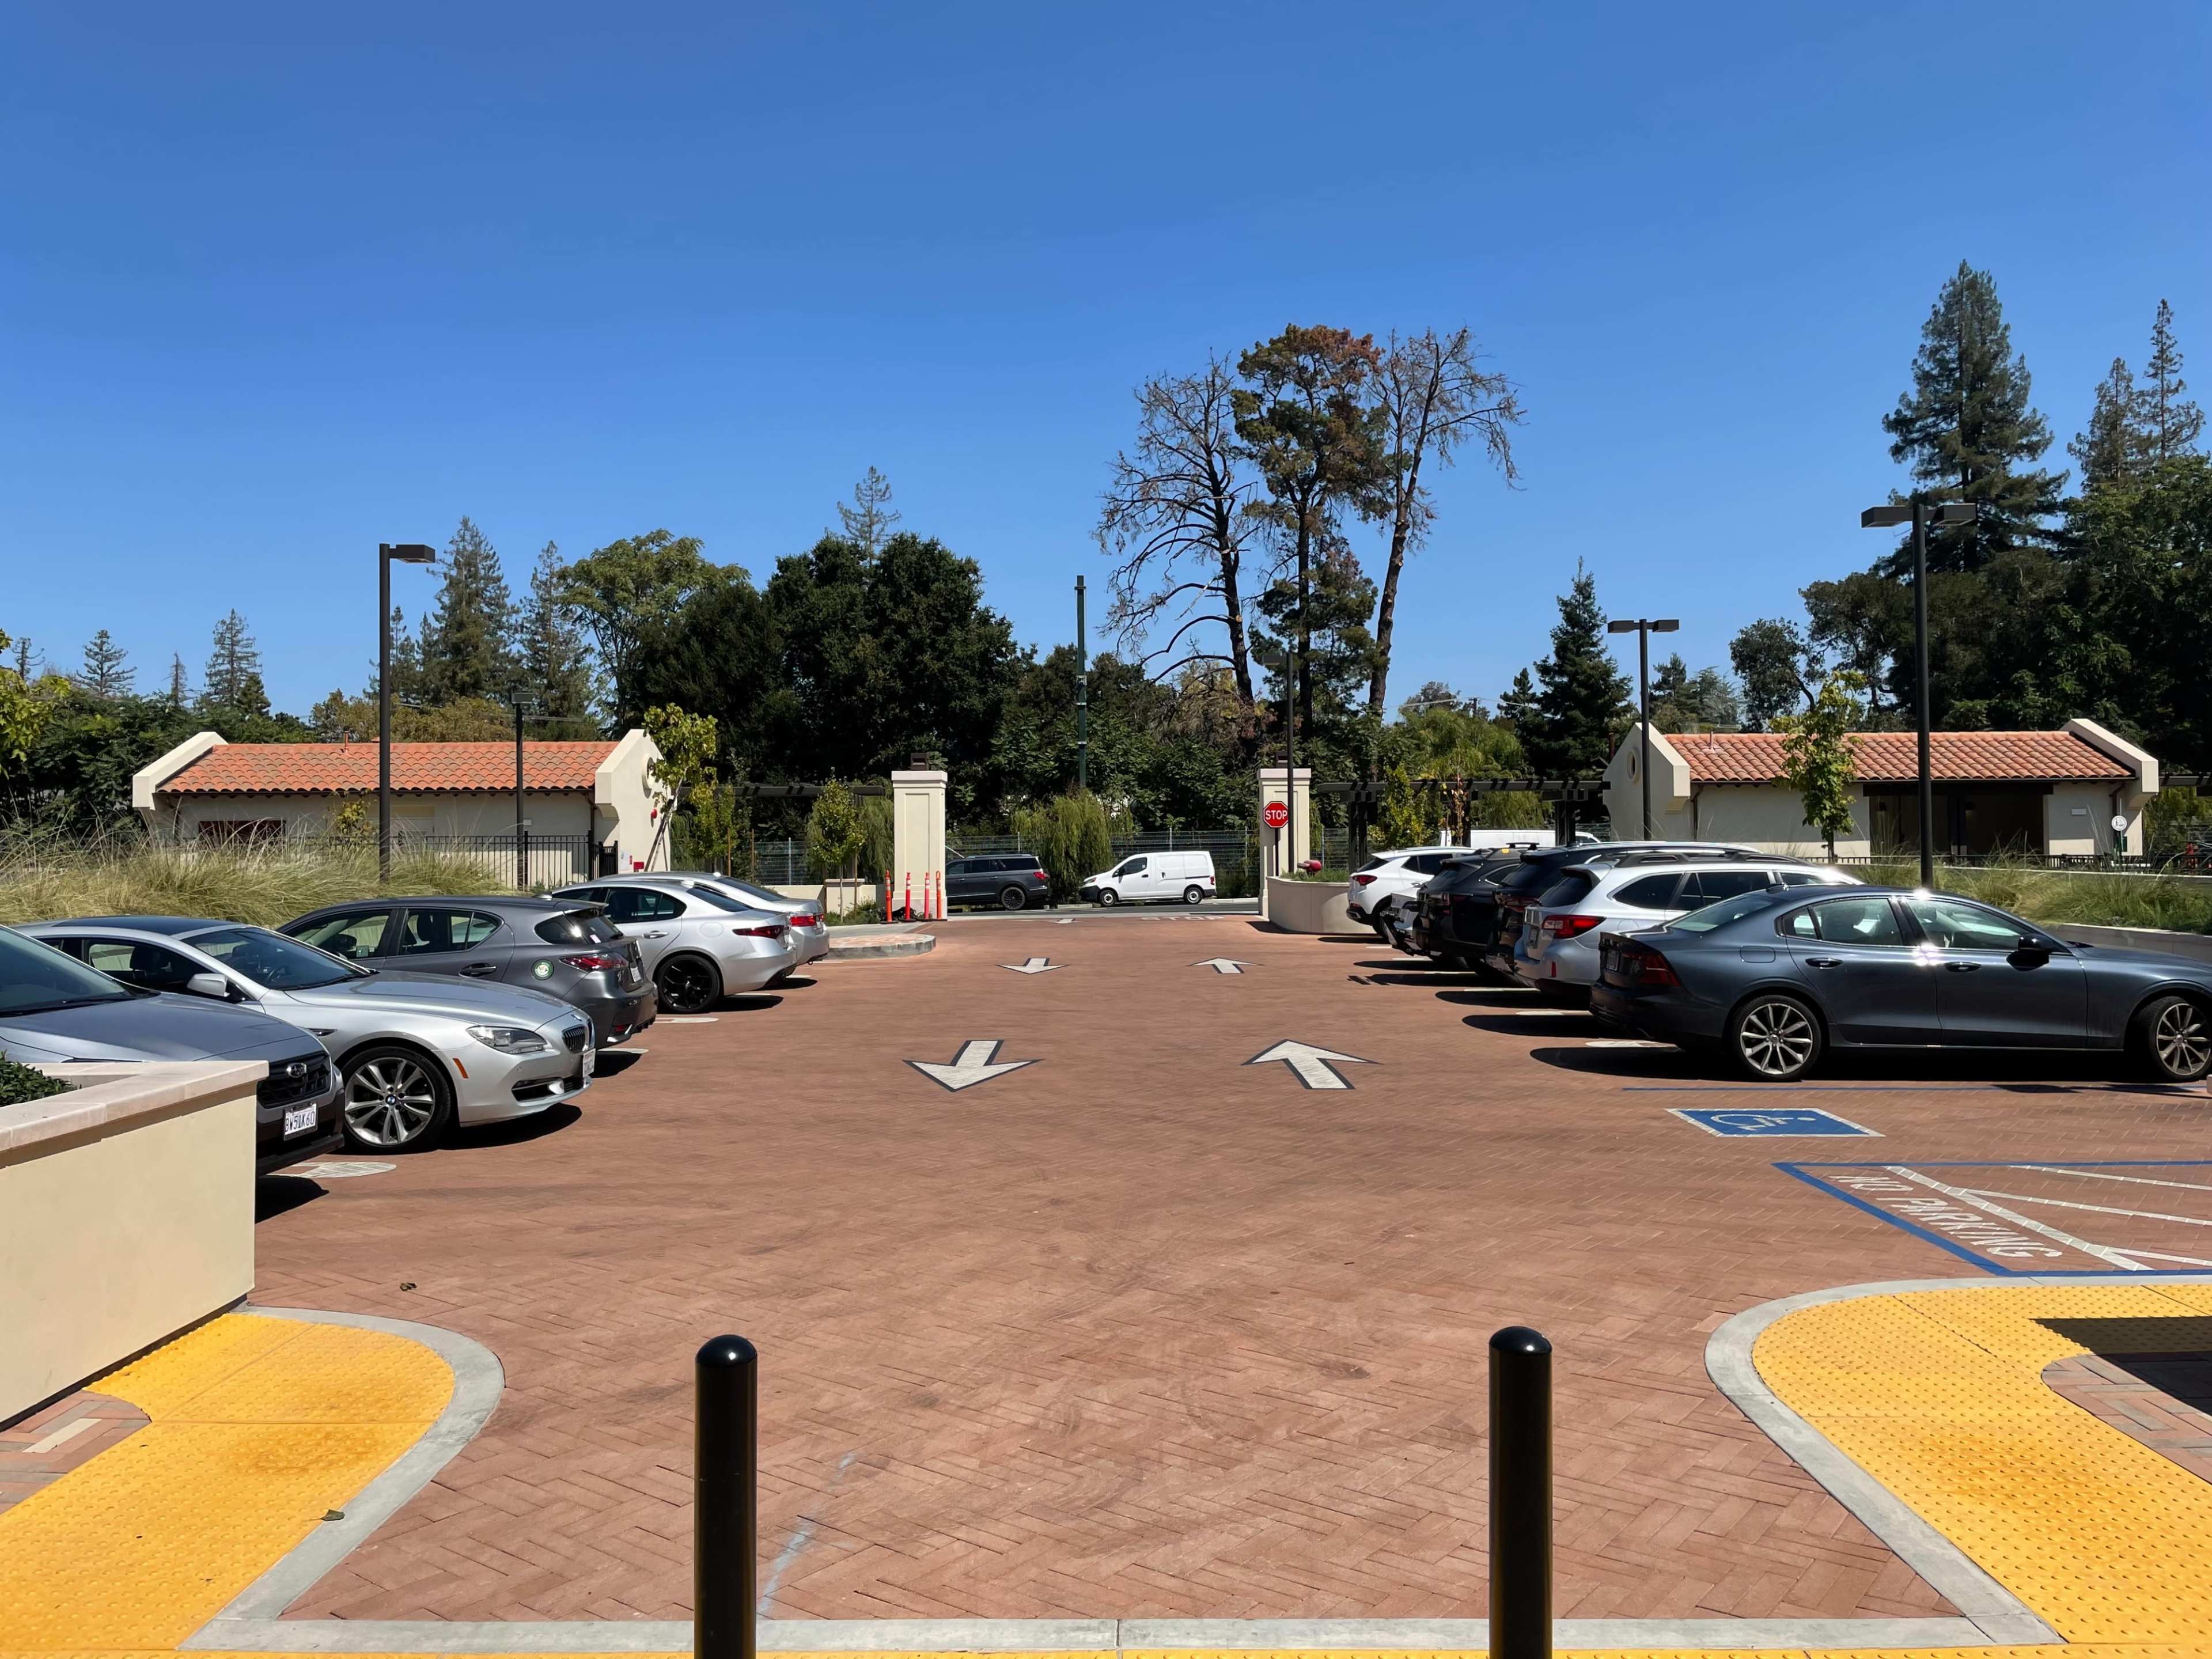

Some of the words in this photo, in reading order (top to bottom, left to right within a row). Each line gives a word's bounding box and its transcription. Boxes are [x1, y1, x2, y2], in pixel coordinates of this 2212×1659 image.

[1266, 810, 1287, 820] STOP
[1828, 1176, 1914, 1191] NO
[1876, 1198, 2063, 1257] PARKING
